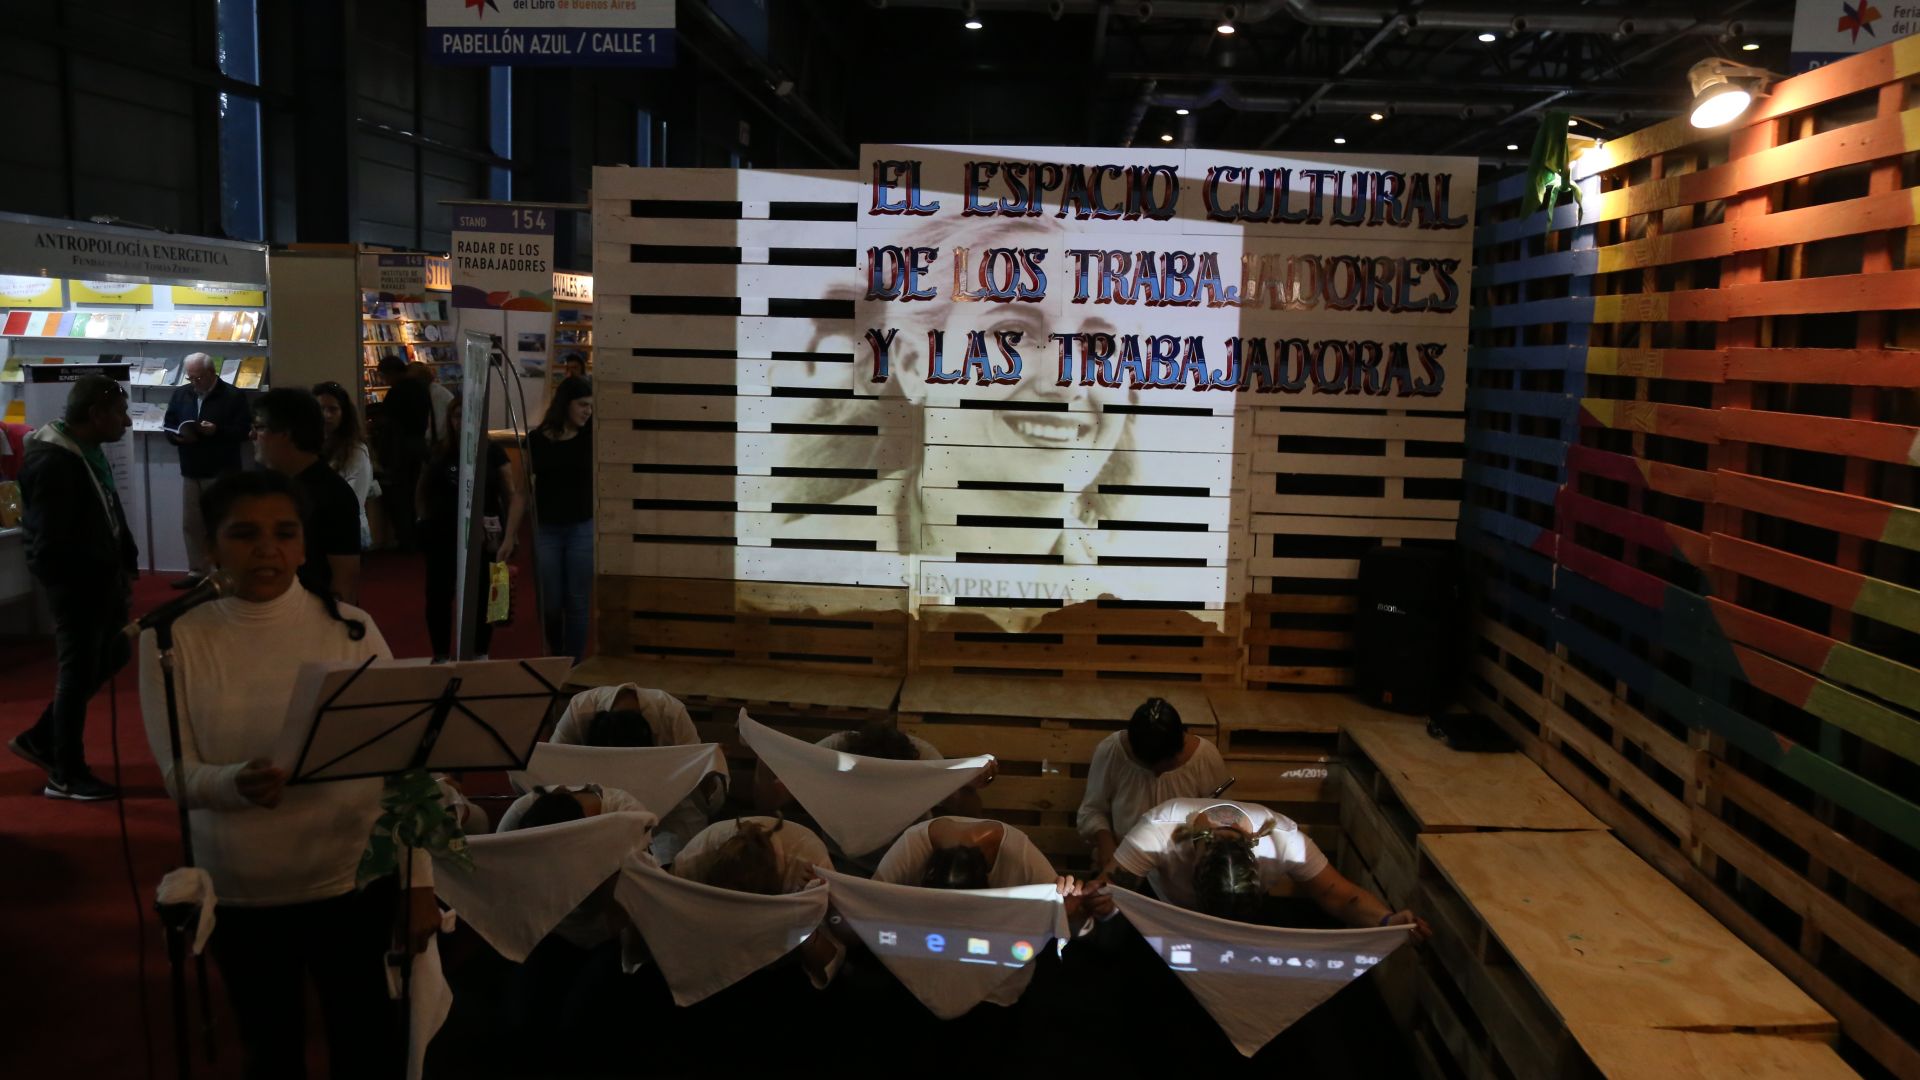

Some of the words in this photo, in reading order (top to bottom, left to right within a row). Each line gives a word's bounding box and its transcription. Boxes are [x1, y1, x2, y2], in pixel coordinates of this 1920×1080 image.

[442, 28, 525, 54] PABELLÓN
[529, 34, 572, 54] AZUL
[576, 31, 588, 54] /
[592, 33, 643, 54] CALLE
[648, 33, 656, 53] 1
[871, 159, 941, 217] EL
[962, 160, 1180, 222] ESPACIO
[1201, 165, 1469, 231] CULTURAL
[459, 216, 488, 228] STAND
[511, 209, 547, 230] 154
[153, 244, 229, 266] ENERGETICA
[457, 241, 496, 254] RADAR
[500, 243, 515, 255] DE
[519, 244, 540, 256] LOS
[458, 257, 546, 273] TRABAJADORES
[865, 244, 940, 303] DE
[951, 245, 1049, 304] LOS
[1064, 248, 1464, 315] TRABAJADORES
[863, 327, 900, 384] Y
[924, 328, 1026, 386] LAS
[1048, 332, 1449, 398] TRABAJADORAS
[901, 572, 1009, 598] SIEMPRE
[1016, 581, 1075, 603] VIVA
